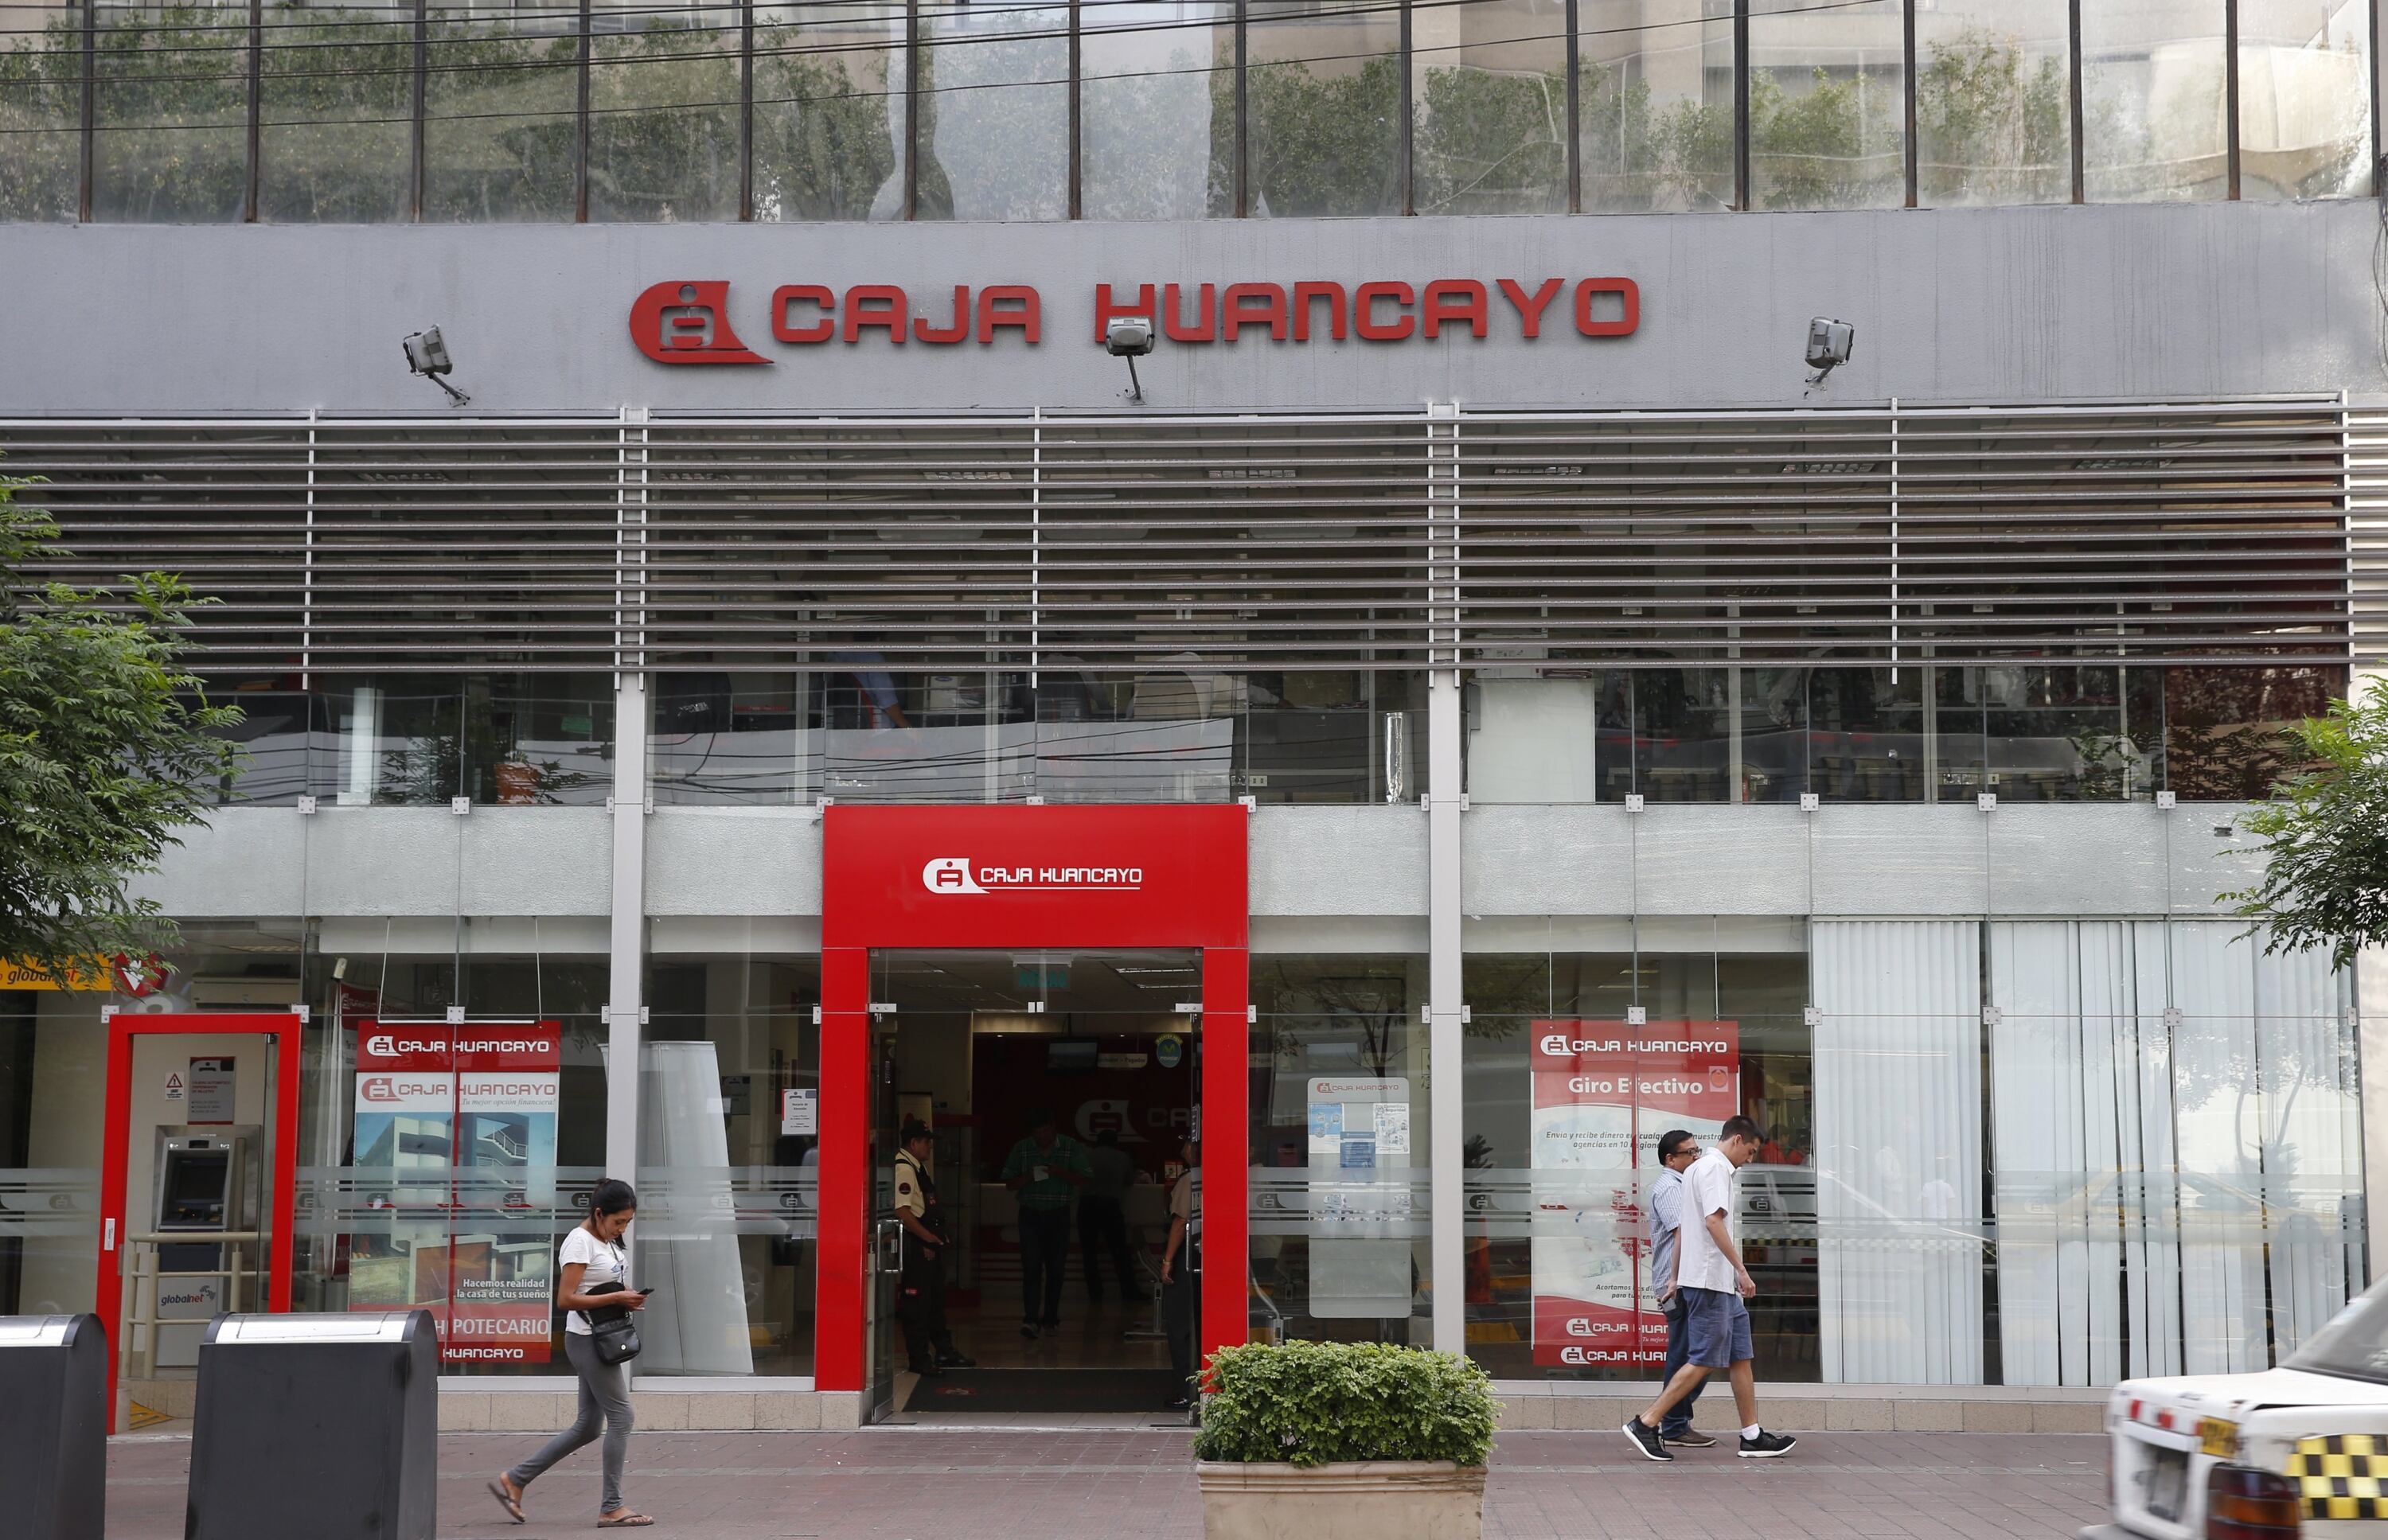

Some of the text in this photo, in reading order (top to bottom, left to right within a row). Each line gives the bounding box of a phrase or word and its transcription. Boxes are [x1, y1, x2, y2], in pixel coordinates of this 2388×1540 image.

[771, 277, 1640, 344] CAJA HUANCAYO
[980, 867, 1142, 883] CAJA HUANCAYO
[398, 1040, 549, 1053] CAJA HUANCAYO
[1572, 1040, 1727, 1053] CAJA HUANCAYO
[398, 1084, 556, 1096] CAJA HUANCAYO
[1568, 1077, 1613, 1094] Giro
[472, 1098, 493, 1107] mejor
[494, 1098, 517, 1107] opción
[1573, 1140, 1607, 1150] agencias
[462, 1278, 545, 1288] Hacemos realidad
[161, 1293, 205, 1306] globalnet
[457, 1289, 465, 1298] la
[488, 1289, 499, 1298] de
[518, 1289, 552, 1299] sueños
[434, 1319, 549, 1335] HPOTECARIO
[1593, 1323, 1629, 1332] CAJA
[443, 1348, 524, 1359] HUANCAYO
[1586, 1351, 1628, 1361] CAJA
